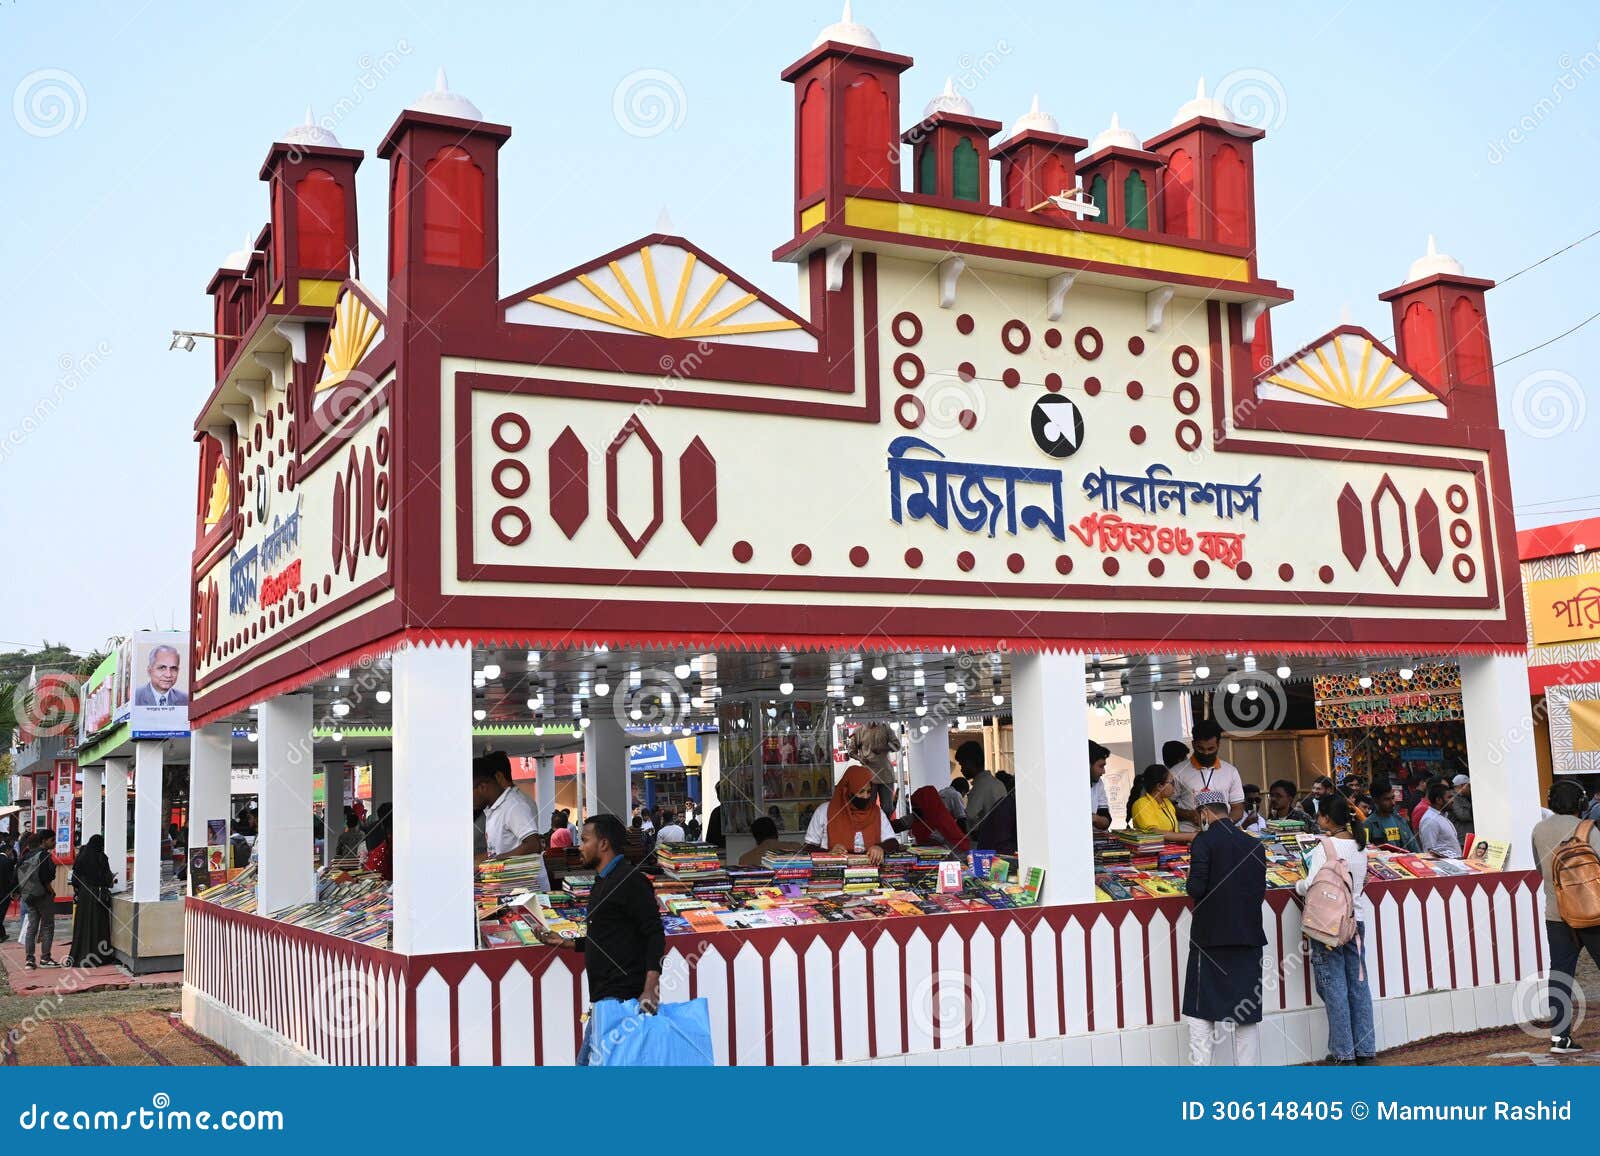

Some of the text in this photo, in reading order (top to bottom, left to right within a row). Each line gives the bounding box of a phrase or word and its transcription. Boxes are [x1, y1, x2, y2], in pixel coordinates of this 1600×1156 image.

[887, 436, 1262, 542] মিজান পাবলিশার্স
[1157, 530, 1194, 555] ৪৬
[1196, 530, 1246, 569] বছর
